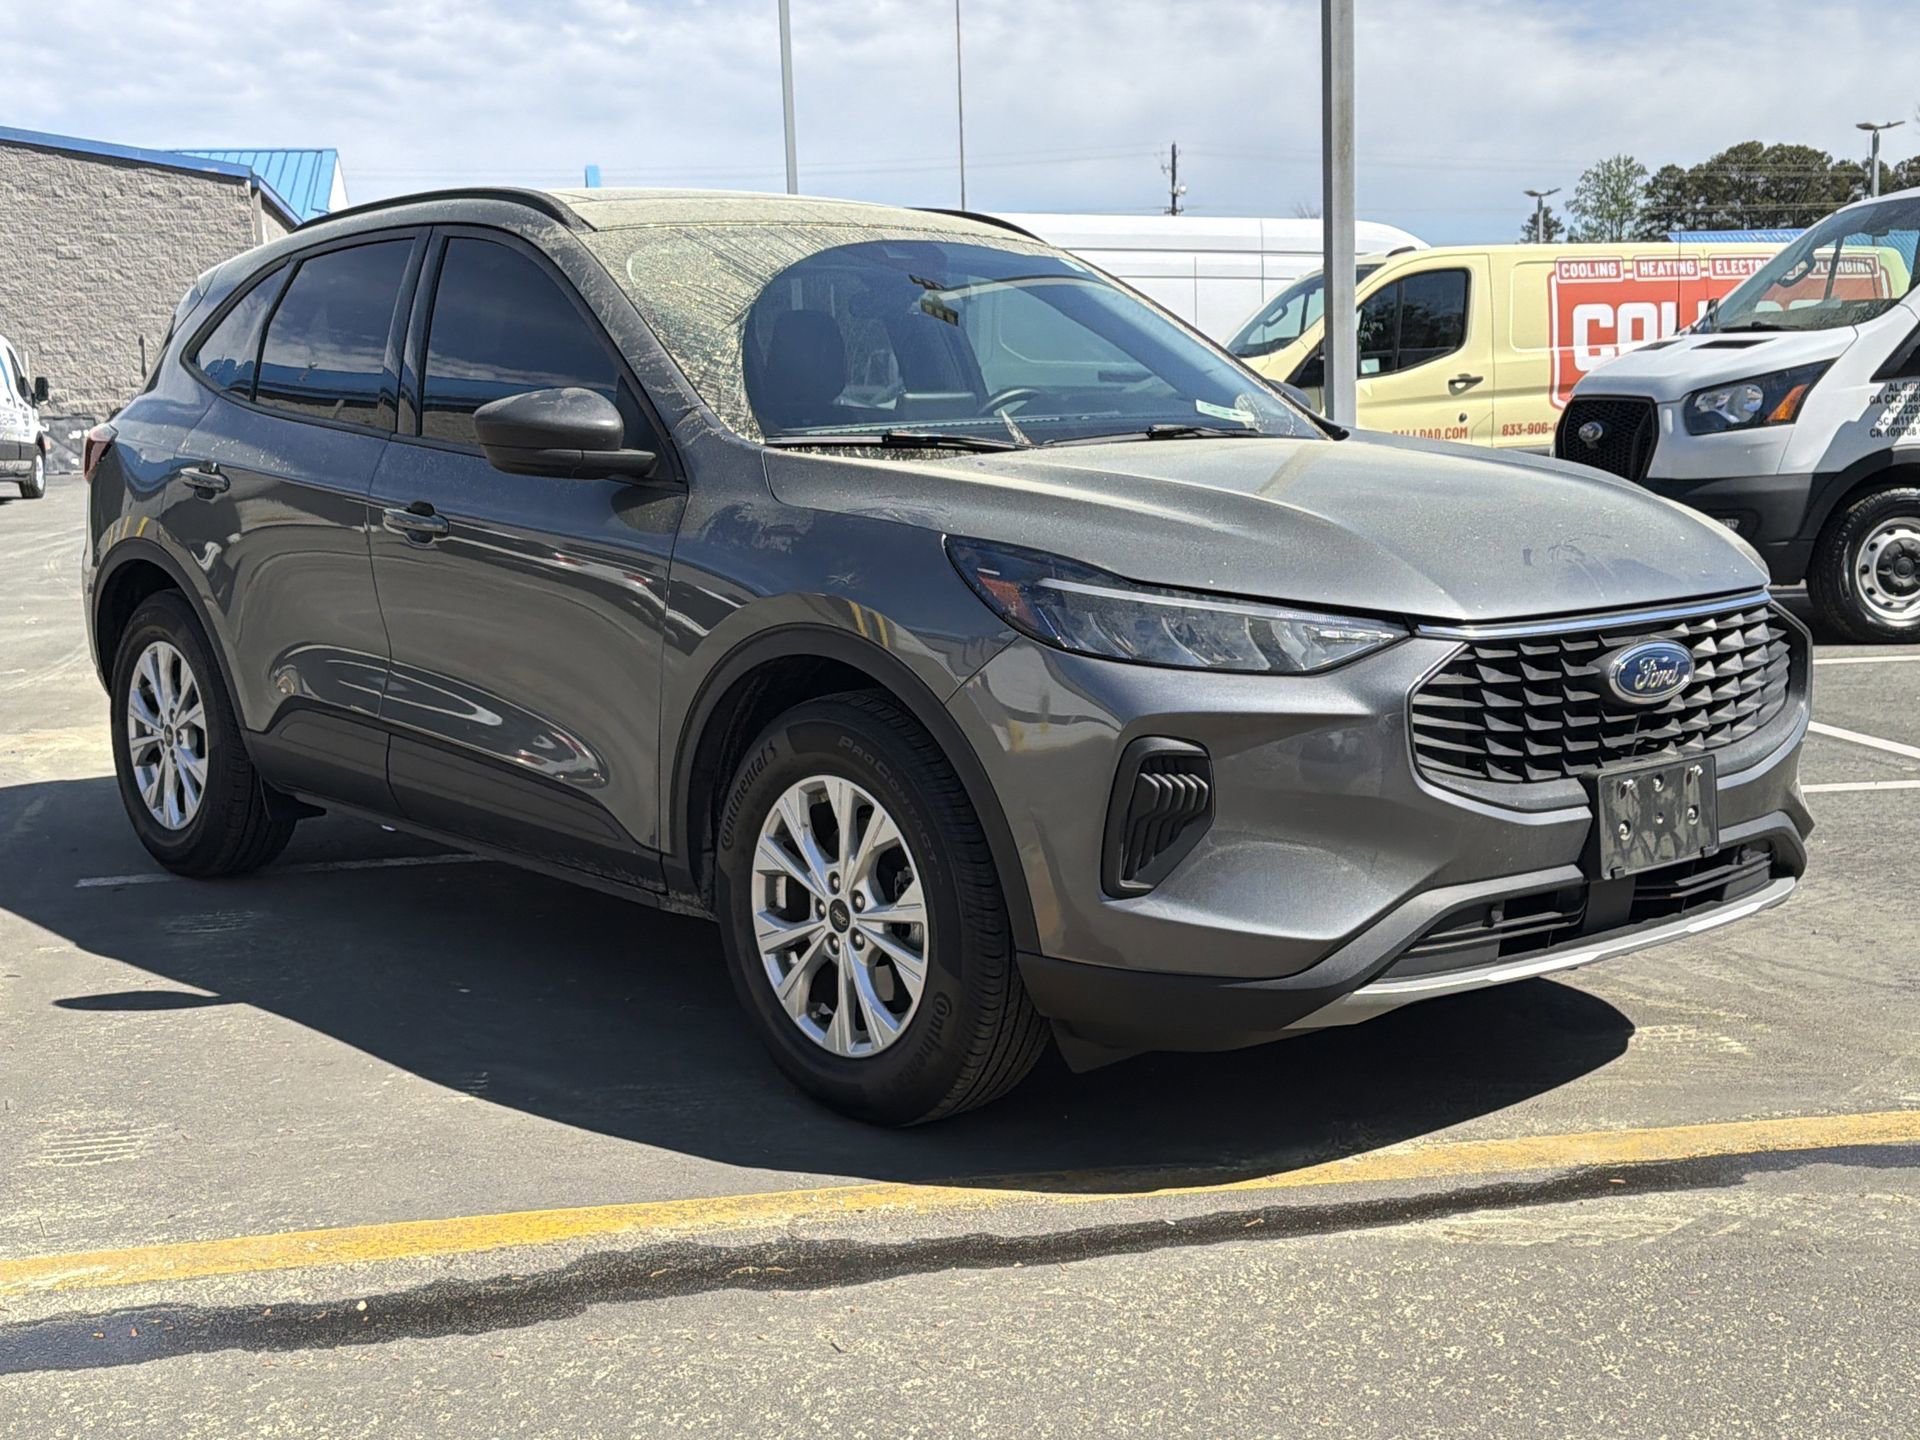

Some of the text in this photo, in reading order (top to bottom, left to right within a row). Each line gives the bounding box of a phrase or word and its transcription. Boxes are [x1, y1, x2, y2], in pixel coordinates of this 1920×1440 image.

[1561, 262, 1617, 278] COOLING
[1640, 260, 1695, 276] HEATING
[1716, 259, 1769, 274] ELECTR
[1634, 655, 1680, 690] Ford
[721, 747, 769, 851] Continental
